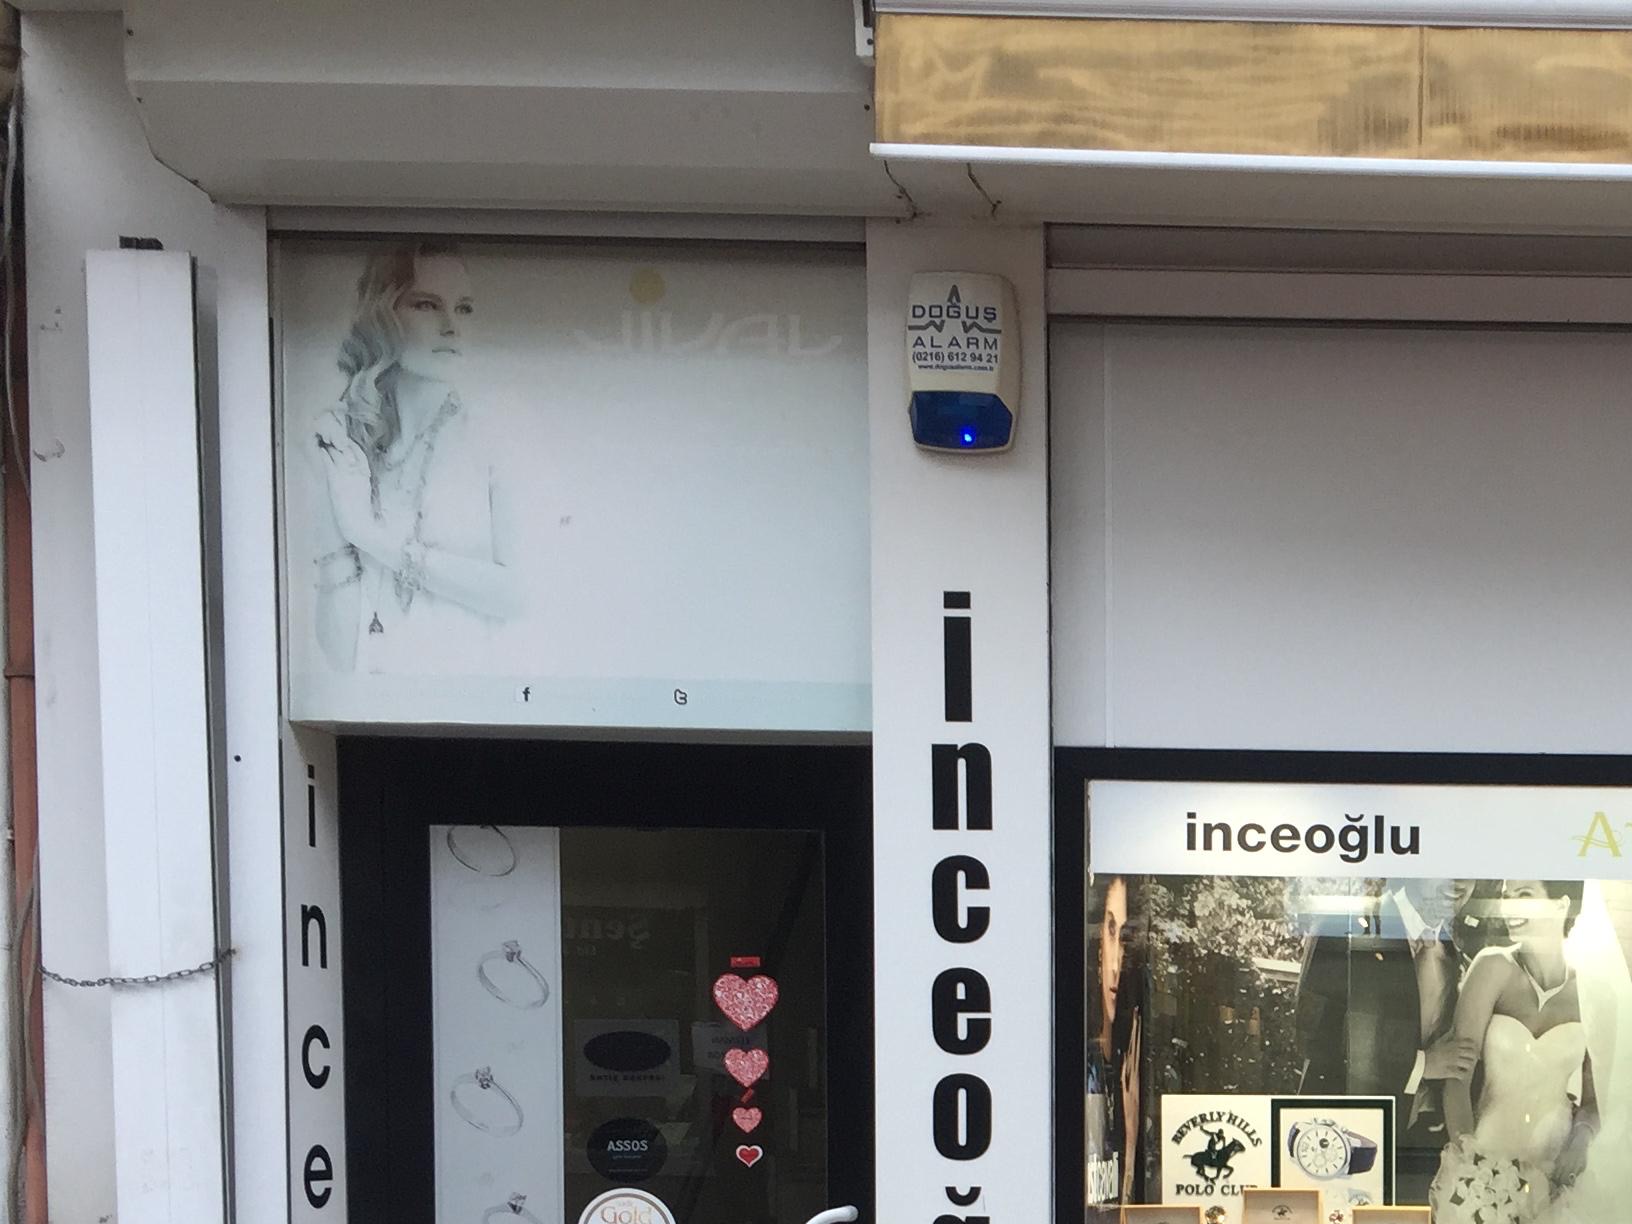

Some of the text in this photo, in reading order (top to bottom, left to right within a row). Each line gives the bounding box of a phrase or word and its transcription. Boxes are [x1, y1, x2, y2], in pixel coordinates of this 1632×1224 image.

[912, 336, 998, 350] ALARM
[912, 351, 998, 364] (0216) 612 94 21
[1186, 812, 1420, 863] inceoğlu
[1171, 1111, 1263, 1148] BEVERLY HILLS
[607, 1140, 649, 1151] ASSOS
[1175, 1184, 1258, 1197] POLO CL
